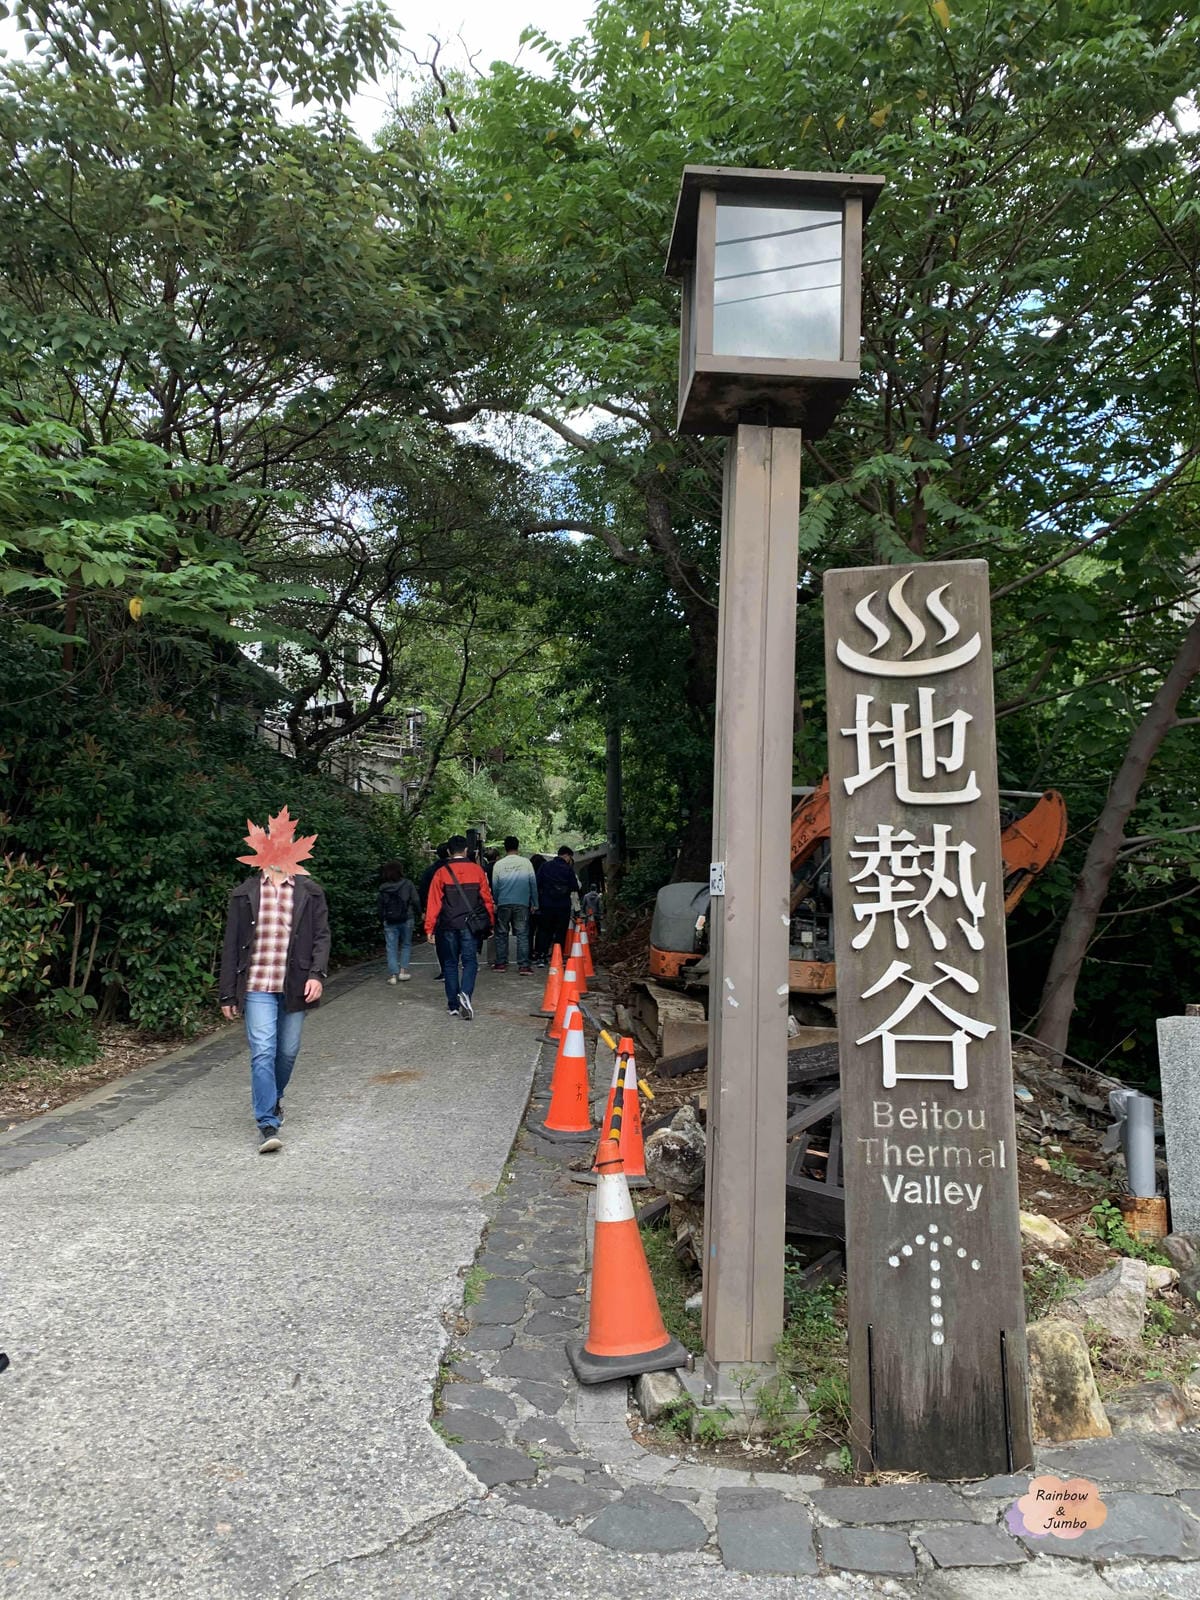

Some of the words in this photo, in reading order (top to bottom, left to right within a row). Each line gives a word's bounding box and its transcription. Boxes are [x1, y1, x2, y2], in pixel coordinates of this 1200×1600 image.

[840, 686, 996, 1090] 地熱谷
[873, 1101, 986, 1130] Beitou
[857, 1137, 1006, 1169] Thermal
[881, 1174, 983, 1212] Valley
